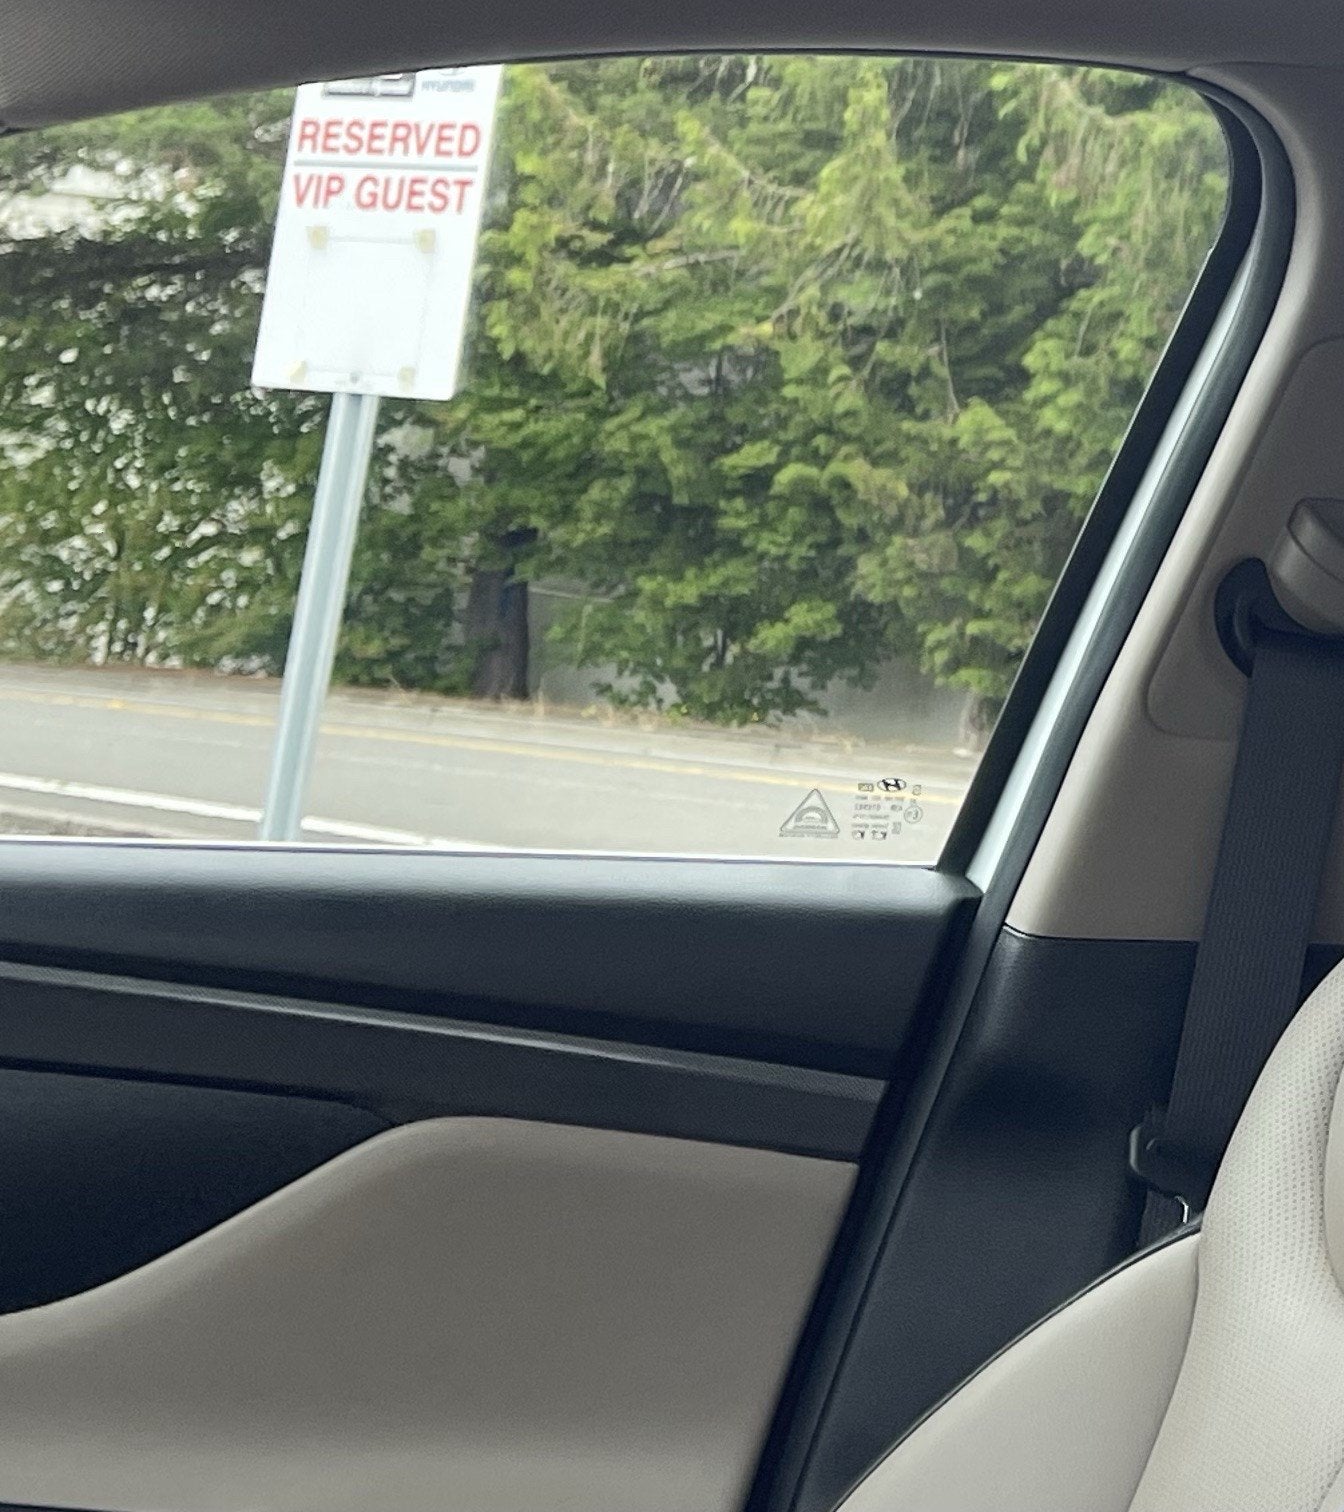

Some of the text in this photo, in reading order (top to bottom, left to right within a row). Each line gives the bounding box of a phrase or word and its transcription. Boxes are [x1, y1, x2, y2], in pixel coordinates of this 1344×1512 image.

[297, 119, 481, 157] RESERVED
[293, 174, 473, 213] VIP GUEST
